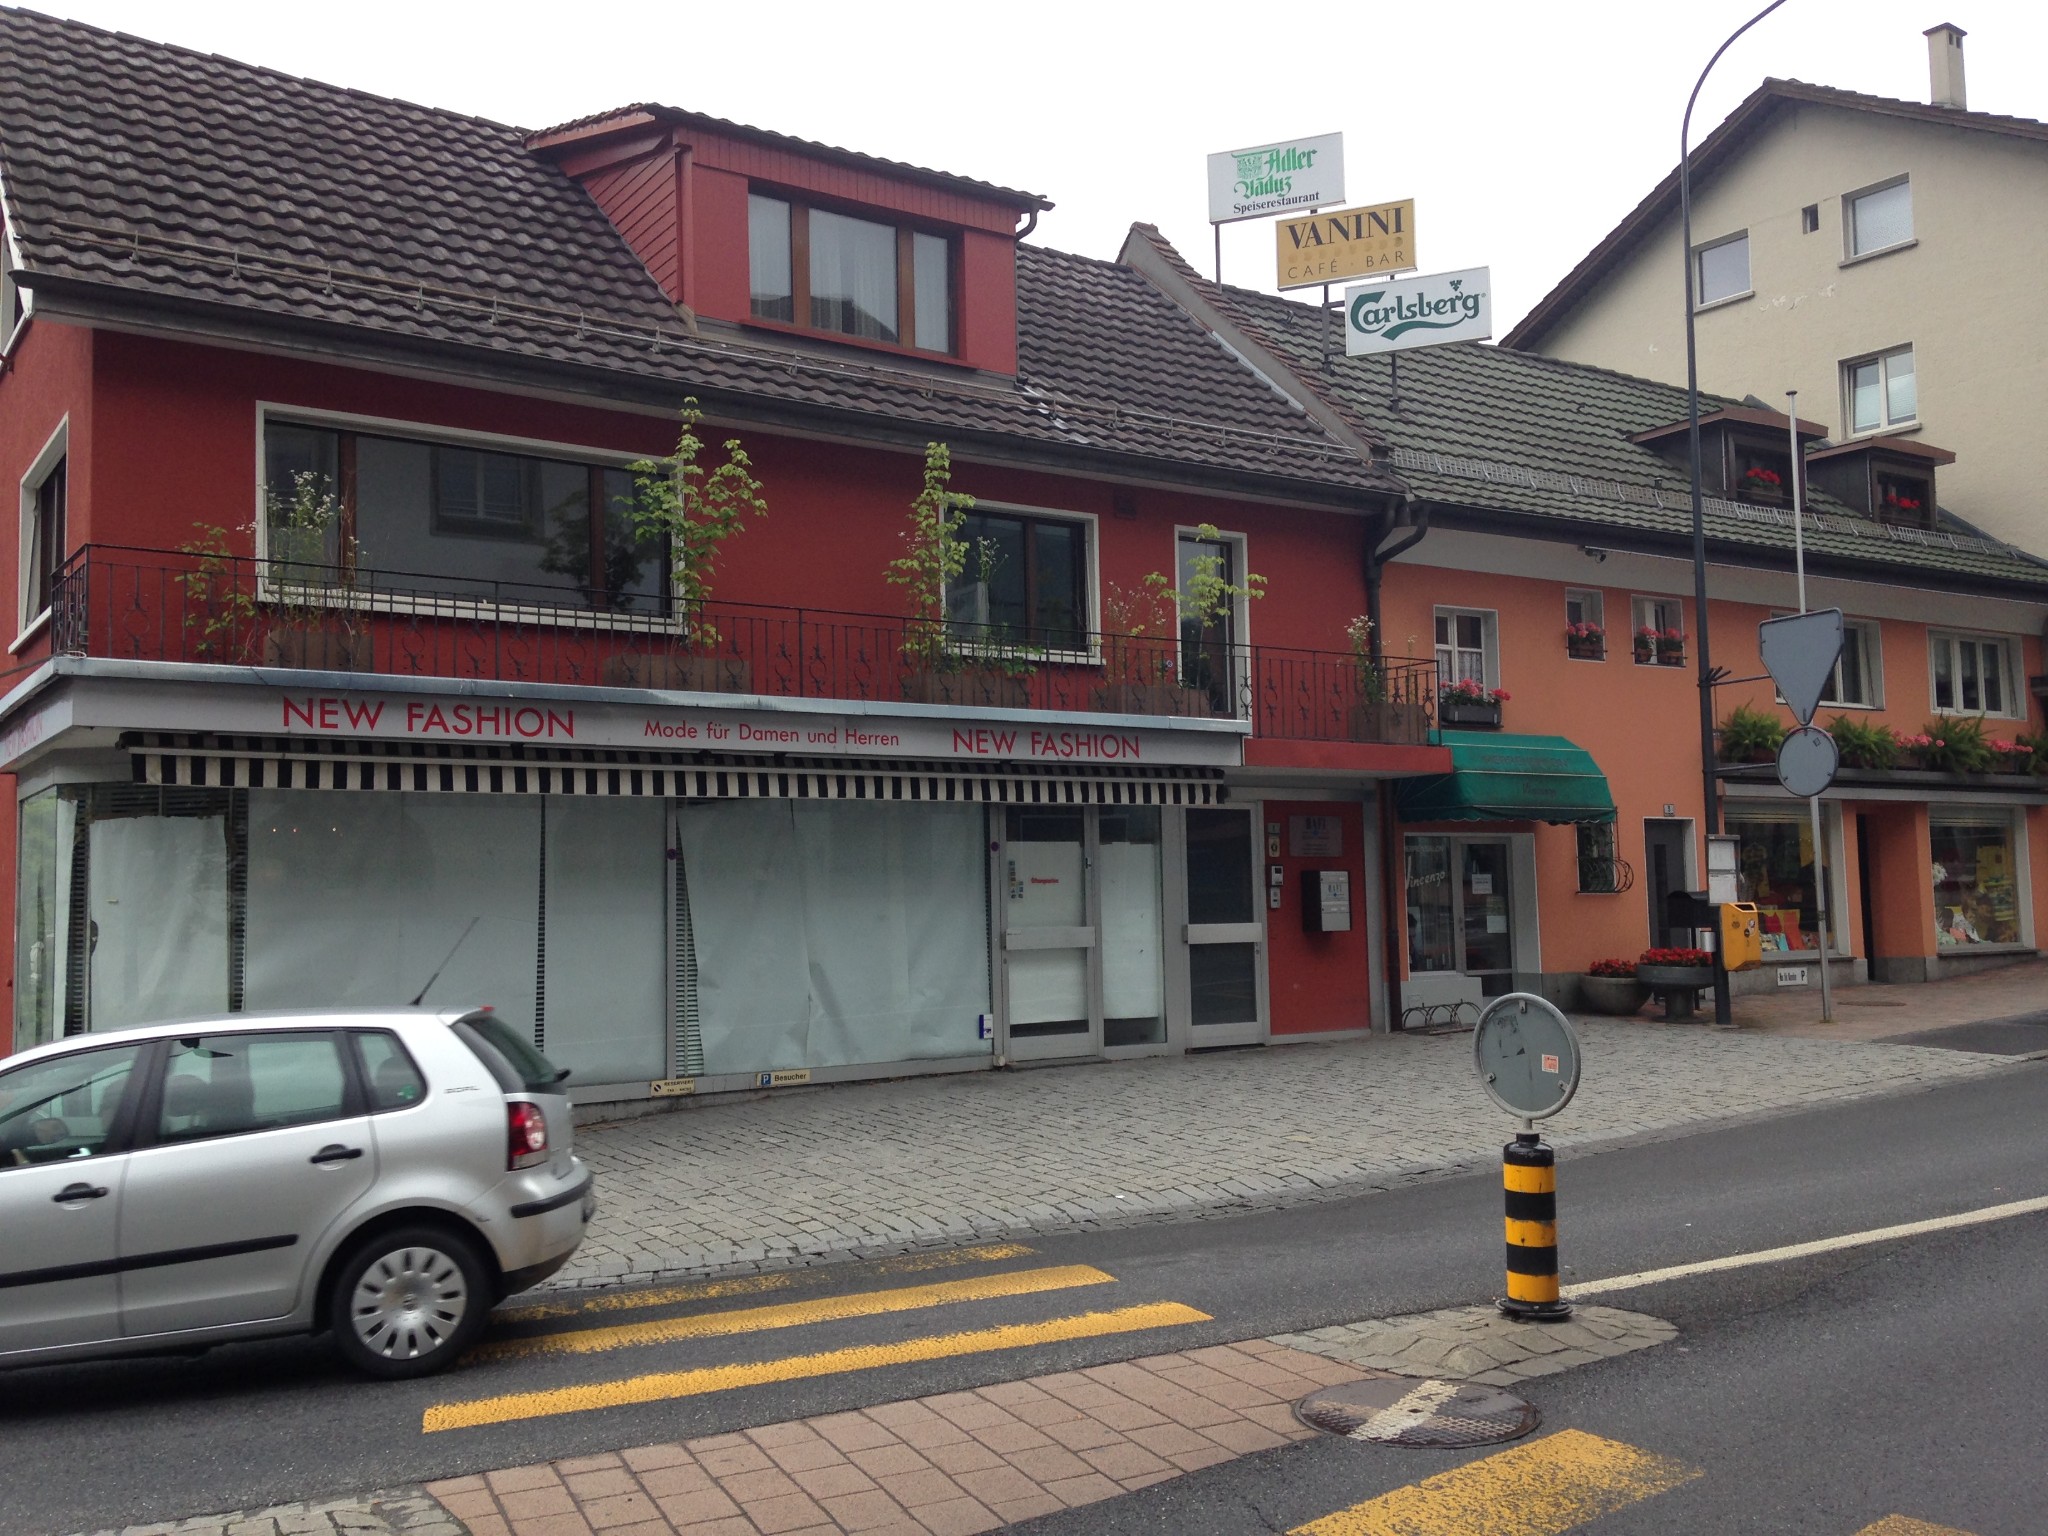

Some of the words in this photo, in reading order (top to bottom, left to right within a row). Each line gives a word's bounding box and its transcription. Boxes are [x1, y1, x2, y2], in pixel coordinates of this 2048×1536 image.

[1231, 147, 1317, 179] Adler
[1233, 175, 1293, 199] Vaduz
[1233, 191, 1320, 214] Speiserestaurant
[1287, 207, 1405, 250] VANINI
[1288, 259, 1338, 279] CAFÉ
[1366, 250, 1405, 268] BAR
[1350, 290, 1481, 334] Carlsberg
[283, 697, 384, 731] NEW
[407, 703, 574, 738] FASHION
[644, 719, 697, 740] Mode
[706, 721, 731, 741] für
[739, 723, 799, 743] Damen
[807, 726, 837, 745] und
[844, 728, 900, 747] Herren
[953, 729, 1017, 755] NEW
[1031, 732, 1140, 759] FASHION
[774, 1073, 807, 1083] Besucher
